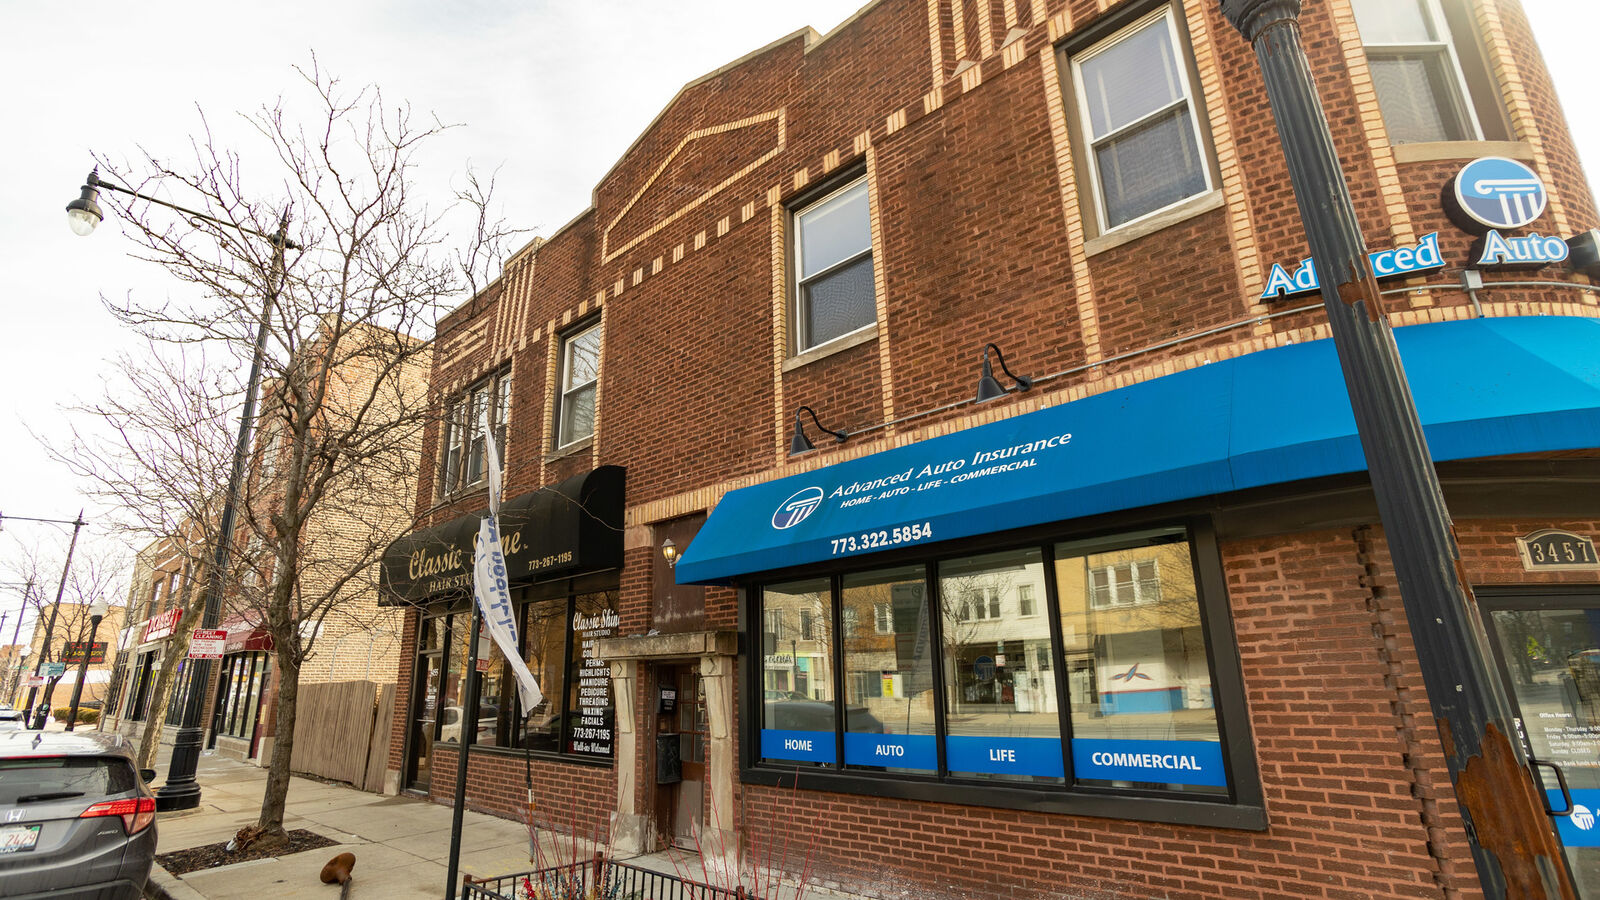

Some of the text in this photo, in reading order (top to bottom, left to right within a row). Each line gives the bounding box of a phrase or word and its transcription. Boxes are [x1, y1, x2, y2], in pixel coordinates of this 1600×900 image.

[1480, 230, 1567, 263] Auto
[1262, 233, 1446, 298] Adced
[828, 432, 1073, 499] Advanced Auto Insurance
[840, 494, 872, 509] HOME
[878, 486, 910, 501] AUTO
[917, 479, 942, 493] LIFE
[950, 458, 1038, 484] COMMERCIAL
[830, 521, 933, 555] 773.322.5854
[1533, 542, 1590, 562] 3457
[409, 543, 462, 580] Classic
[528, 551, 572, 571] 773-267-1195
[429, 573, 475, 593] HAIR STU
[573, 612, 600, 631] Classic
[582, 629, 611, 638] HAIR STUDIO
[582, 649, 593, 658] COL
[585, 659, 605, 667] PERMS
[579, 668, 610, 677] HIGHLIGHTS
[580, 678, 609, 686] MANICURE
[580, 687, 607, 696] PEDICURE
[579, 697, 609, 706] THREADING
[582, 707, 604, 716] WAXING
[580, 716, 604, 726] FACIALS
[573, 727, 611, 740] 773-267-1195
[784, 739, 813, 753] HOME
[875, 744, 904, 758] AUTO
[989, 748, 1016, 763] LIFE
[1091, 751, 1202, 771] COMMERCIAL
